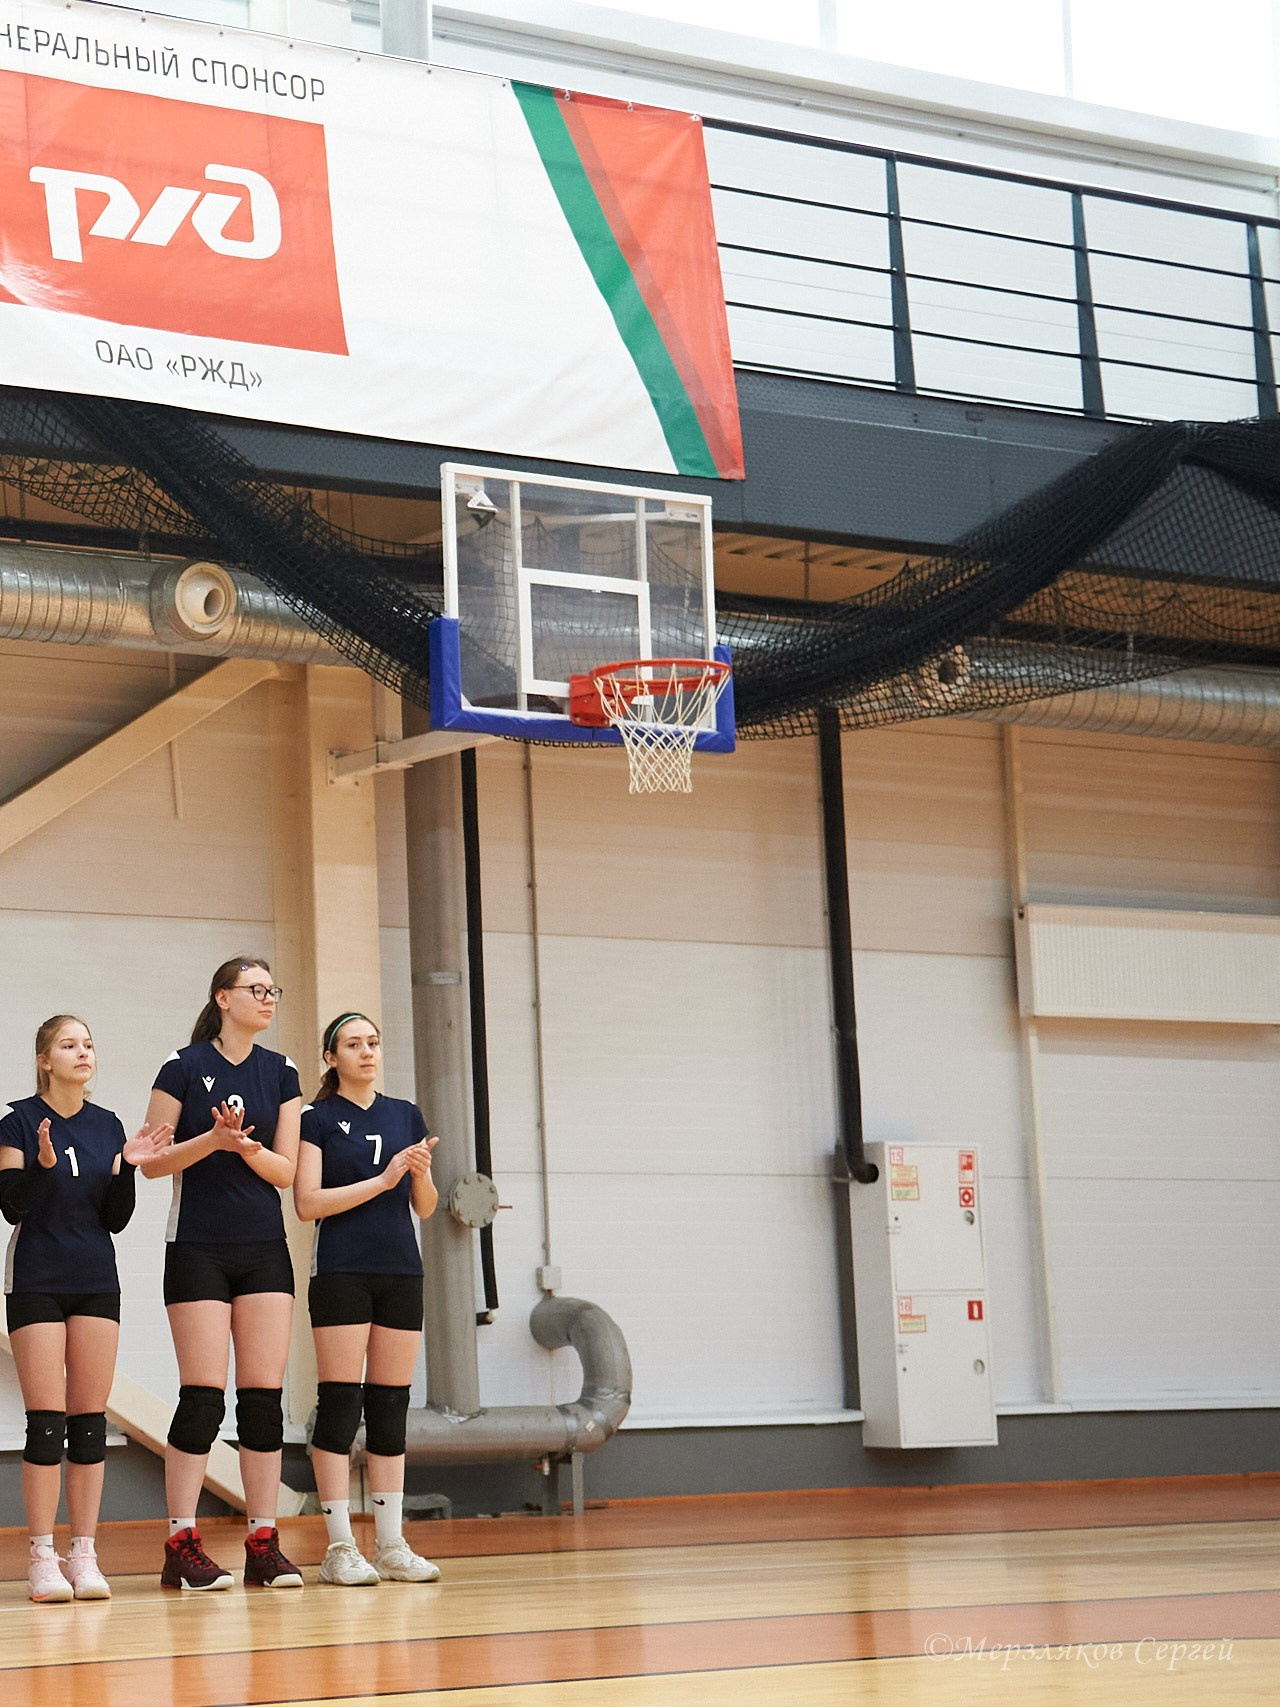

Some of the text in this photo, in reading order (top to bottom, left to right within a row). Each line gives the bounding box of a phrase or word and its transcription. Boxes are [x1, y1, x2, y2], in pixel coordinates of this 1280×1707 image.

[192, 56, 326, 103] СПОНСОР
[95, 338, 264, 392] ОАО «РЖД»
[64, 1146, 79, 1177] 1
[365, 1134, 383, 1165] 7
